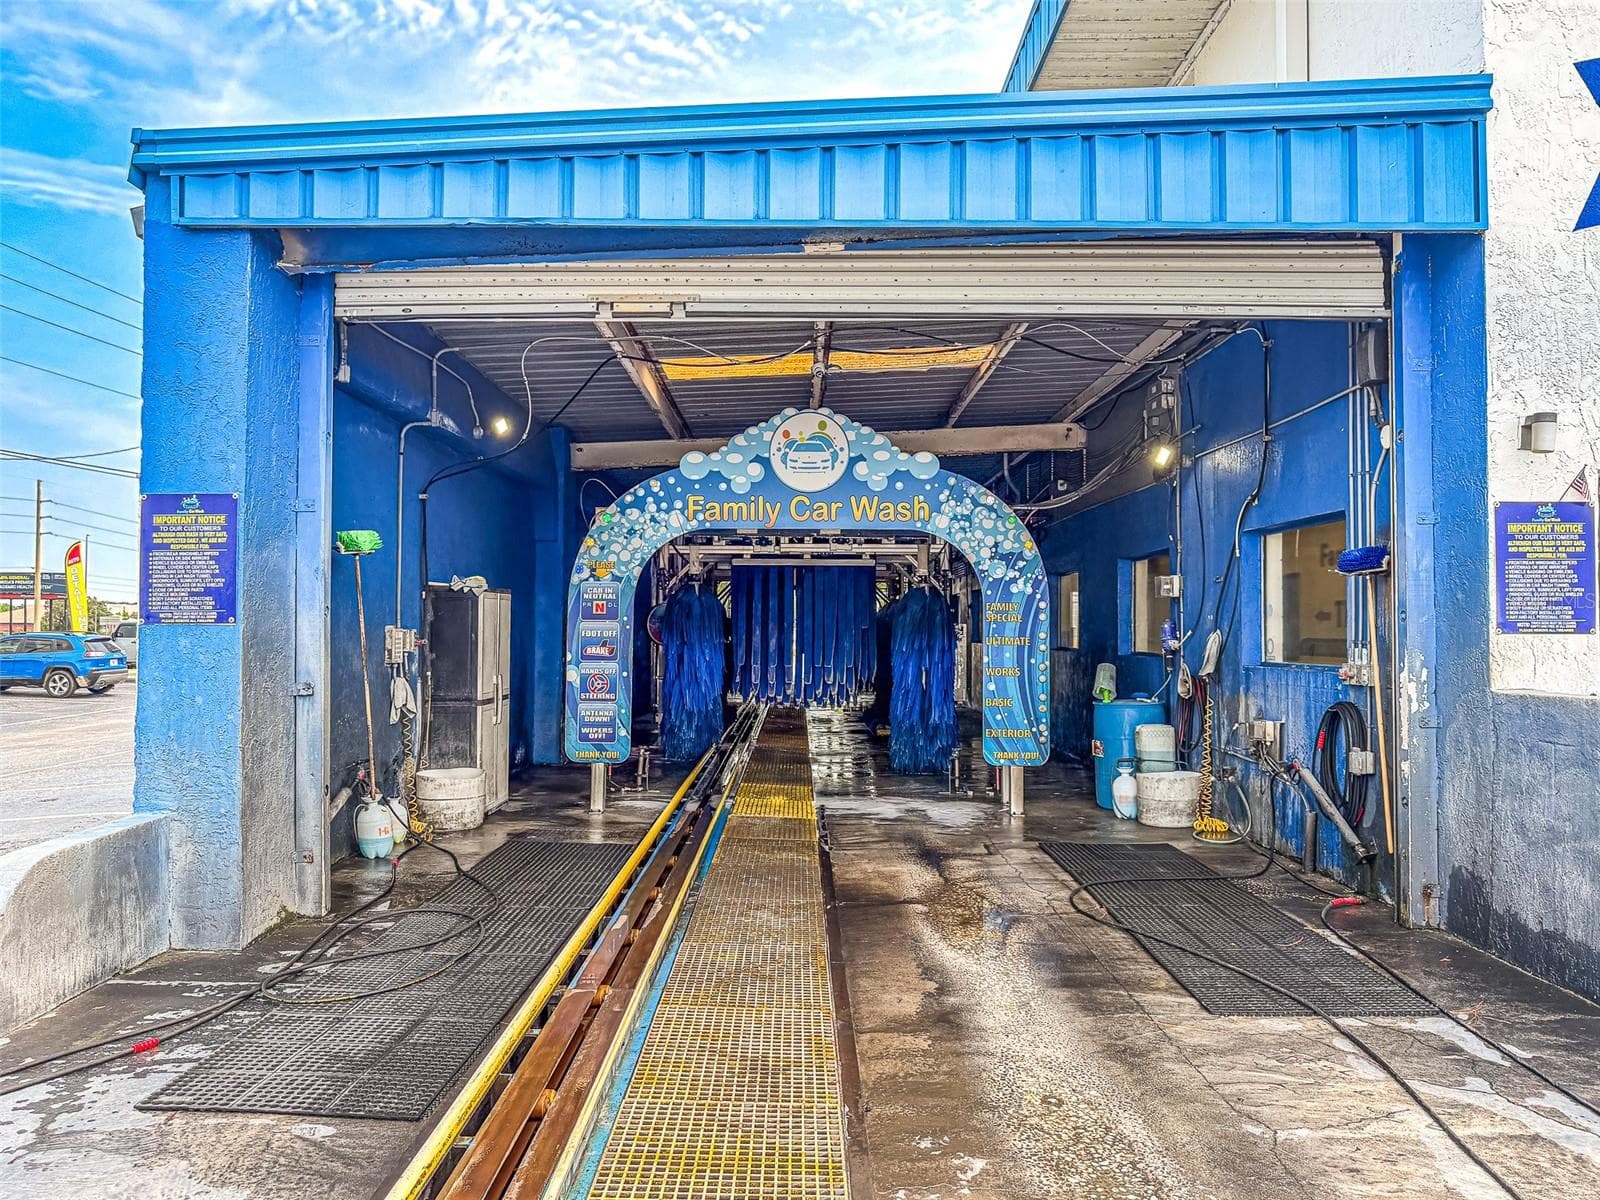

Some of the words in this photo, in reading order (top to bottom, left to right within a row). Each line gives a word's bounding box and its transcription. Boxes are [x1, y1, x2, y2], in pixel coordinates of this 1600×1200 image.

[687, 495, 782, 529] Family
[789, 495, 843, 522] Car
[850, 495, 931, 522] Wash
[153, 516, 195, 524] IMPORTANT
[198, 516, 225, 524] NOTICE
[1508, 524, 1552, 532] IMPORTANT
[1554, 524, 1583, 532] NOTICE
[587, 561, 615, 569] PLEASE
[595, 603, 605, 612] N
[986, 602, 1018, 611] FAMILY
[986, 613, 1022, 622] SPECIAL
[985, 637, 1031, 646] ULTIMATE
[586, 646, 609, 654] BRAKE
[986, 668, 1021, 676] WORKS
[985, 698, 1013, 707] BASIC
[985, 729, 1031, 738] EXTERIOR
